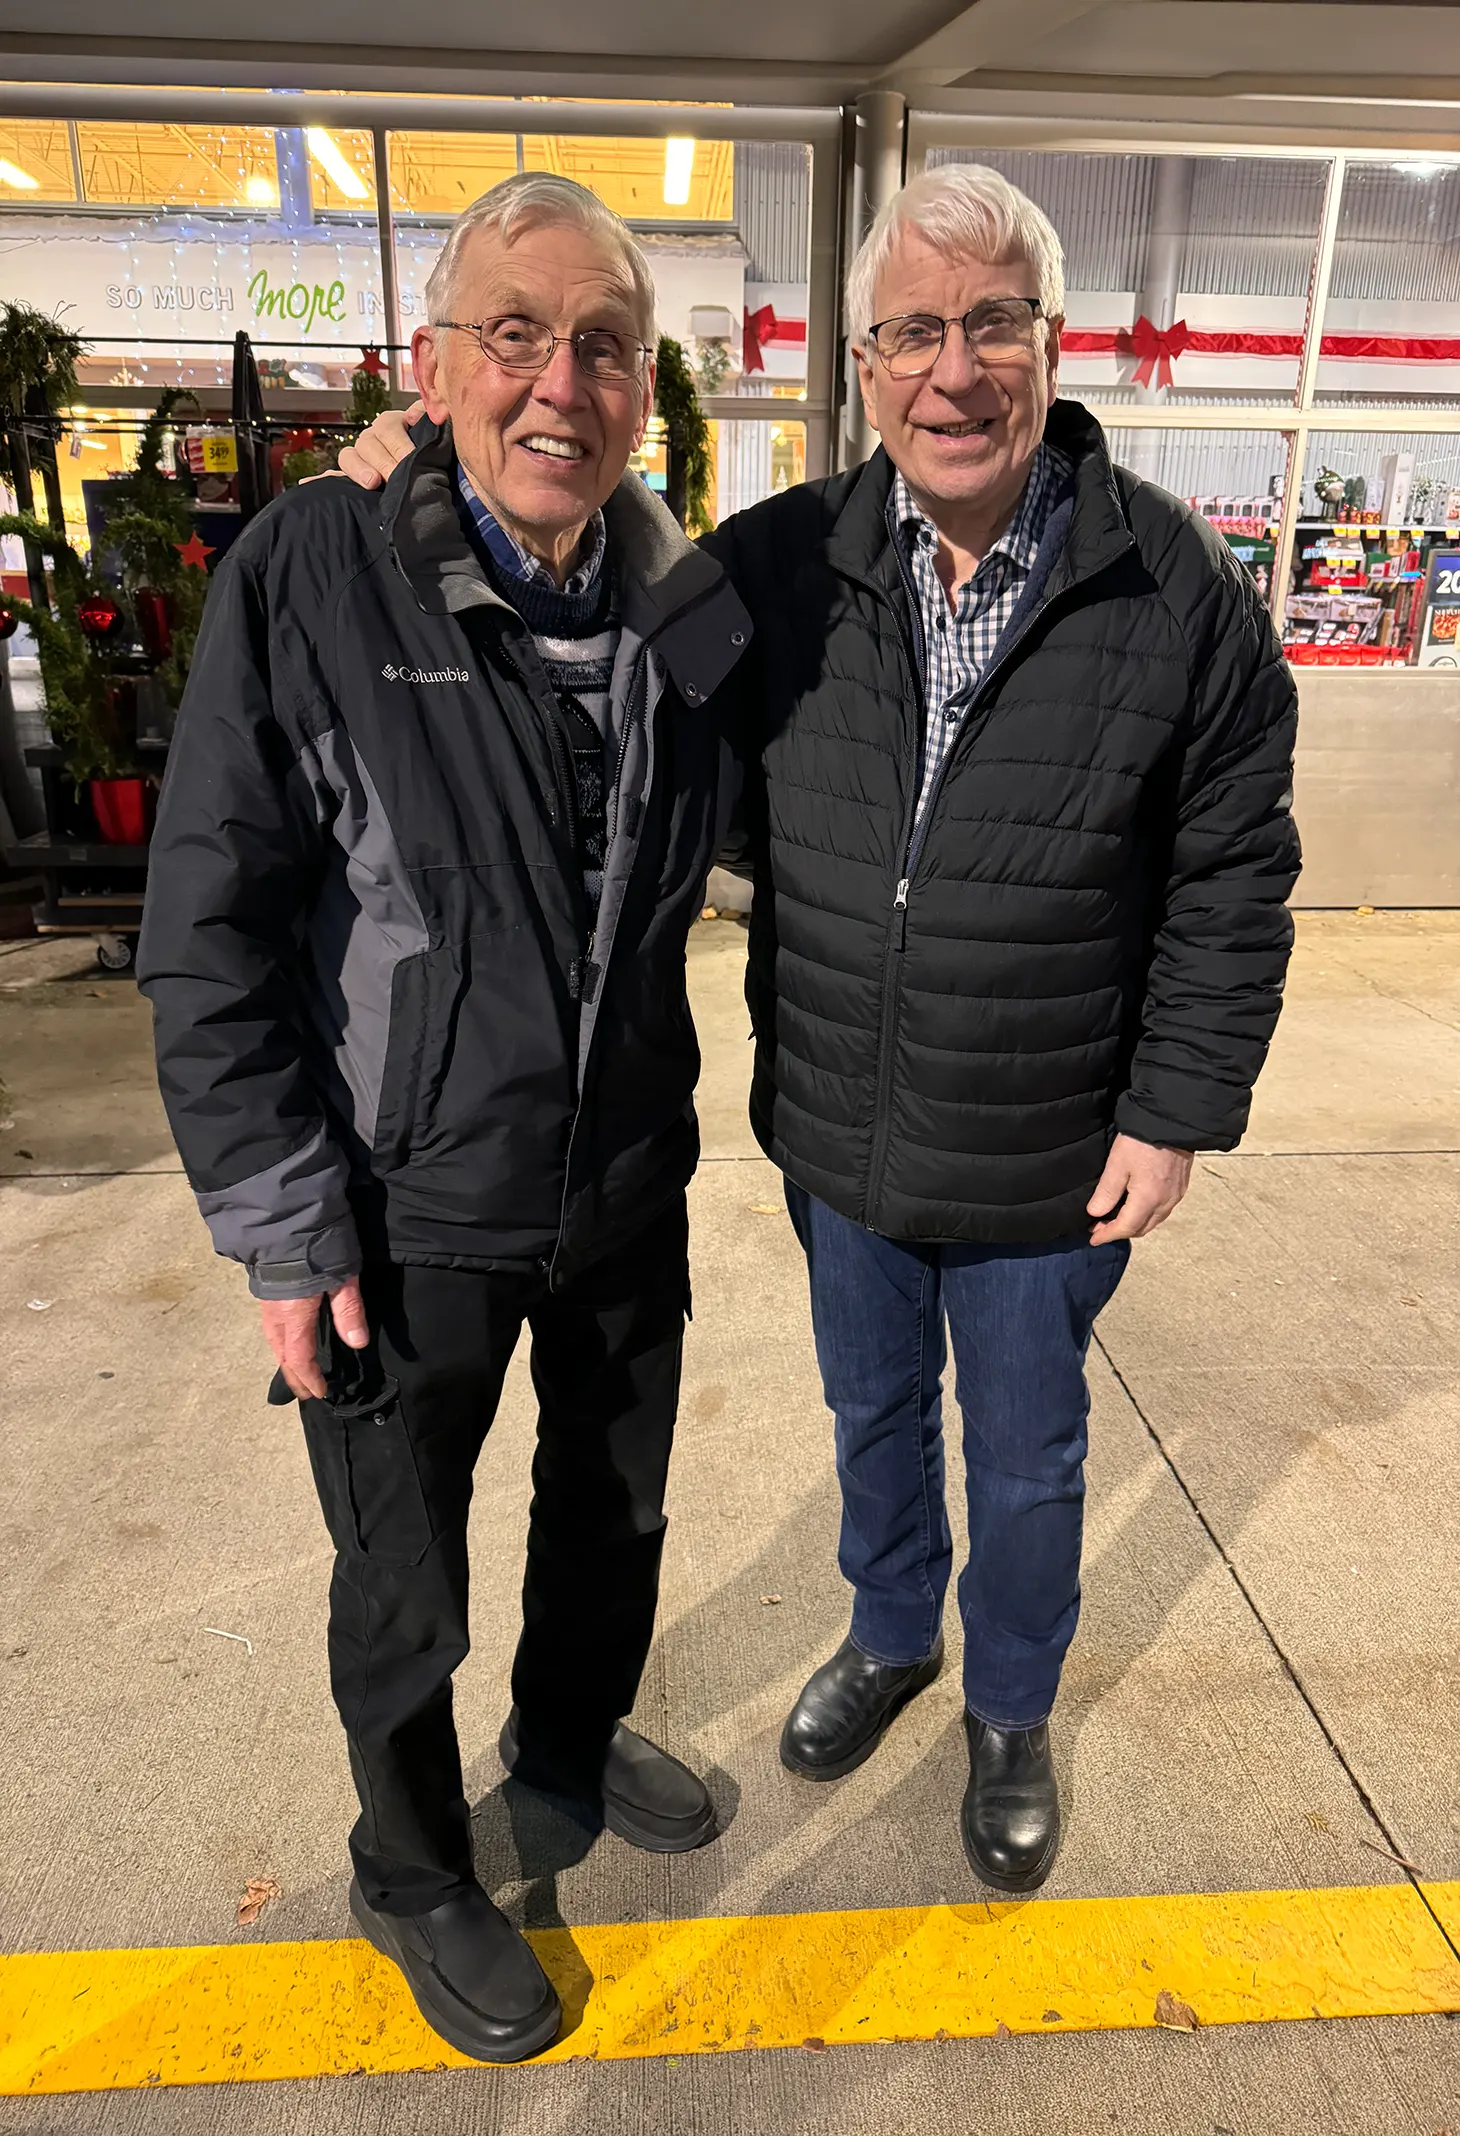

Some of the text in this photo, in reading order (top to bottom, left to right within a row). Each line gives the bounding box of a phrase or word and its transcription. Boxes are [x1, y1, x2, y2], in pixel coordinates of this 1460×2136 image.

[105, 284, 143, 309] SO
[152, 285, 234, 311] MUCH
[247, 269, 347, 334] more
[357, 290, 385, 315] IN
[398, 666, 469, 683] Columbia
